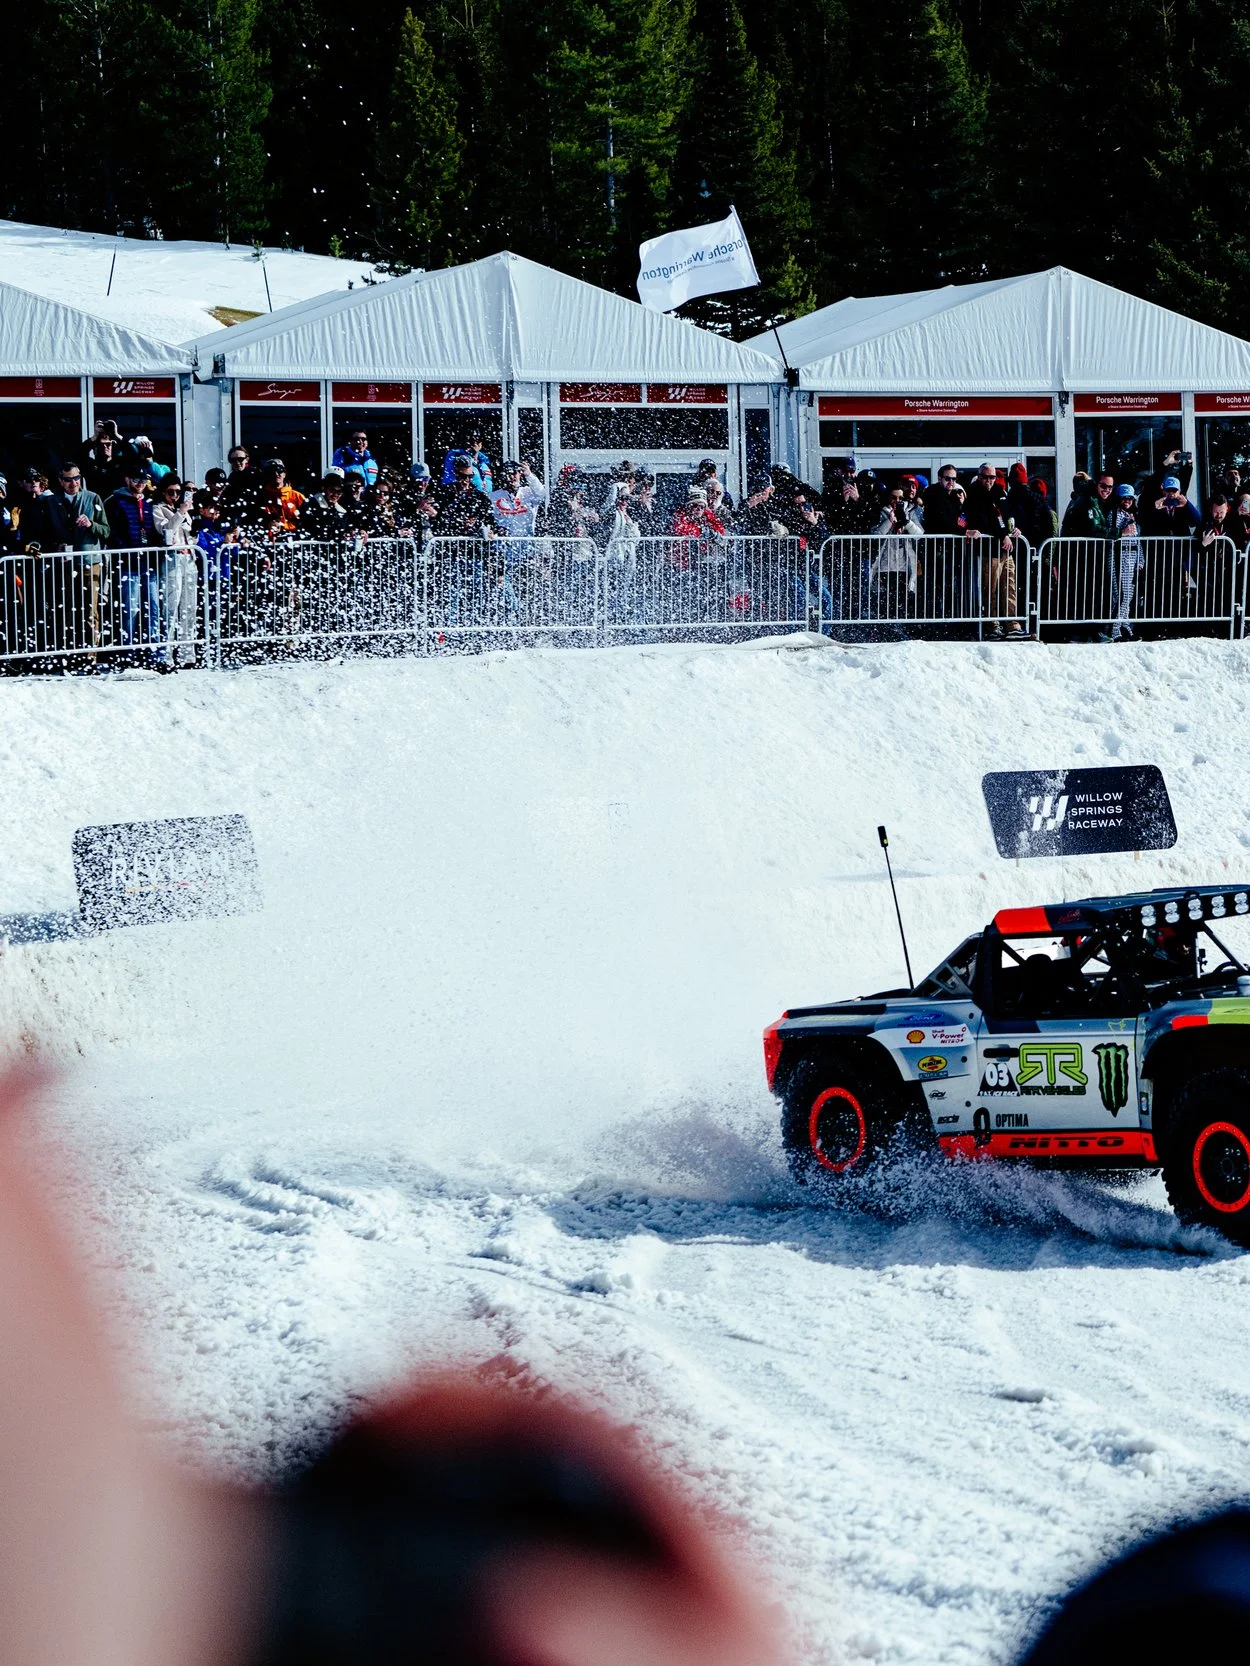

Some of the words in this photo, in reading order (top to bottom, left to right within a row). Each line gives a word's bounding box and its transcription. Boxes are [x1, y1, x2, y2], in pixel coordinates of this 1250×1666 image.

[904, 399, 931, 407] Porsche
[932, 399, 969, 409] Warrington
[1095, 396, 1122, 404] Porsche
[1123, 396, 1159, 405] Warrington
[1216, 396, 1242, 404] Porsche
[1075, 791, 1123, 802] WILLOW
[1071, 805, 1123, 816] SPRINGS
[1068, 818, 1123, 830] RACEWAY
[985, 1063, 1010, 1087] 03
[995, 1113, 1029, 1127] OPTIMA
[1009, 1135, 1125, 1149] NITTO
